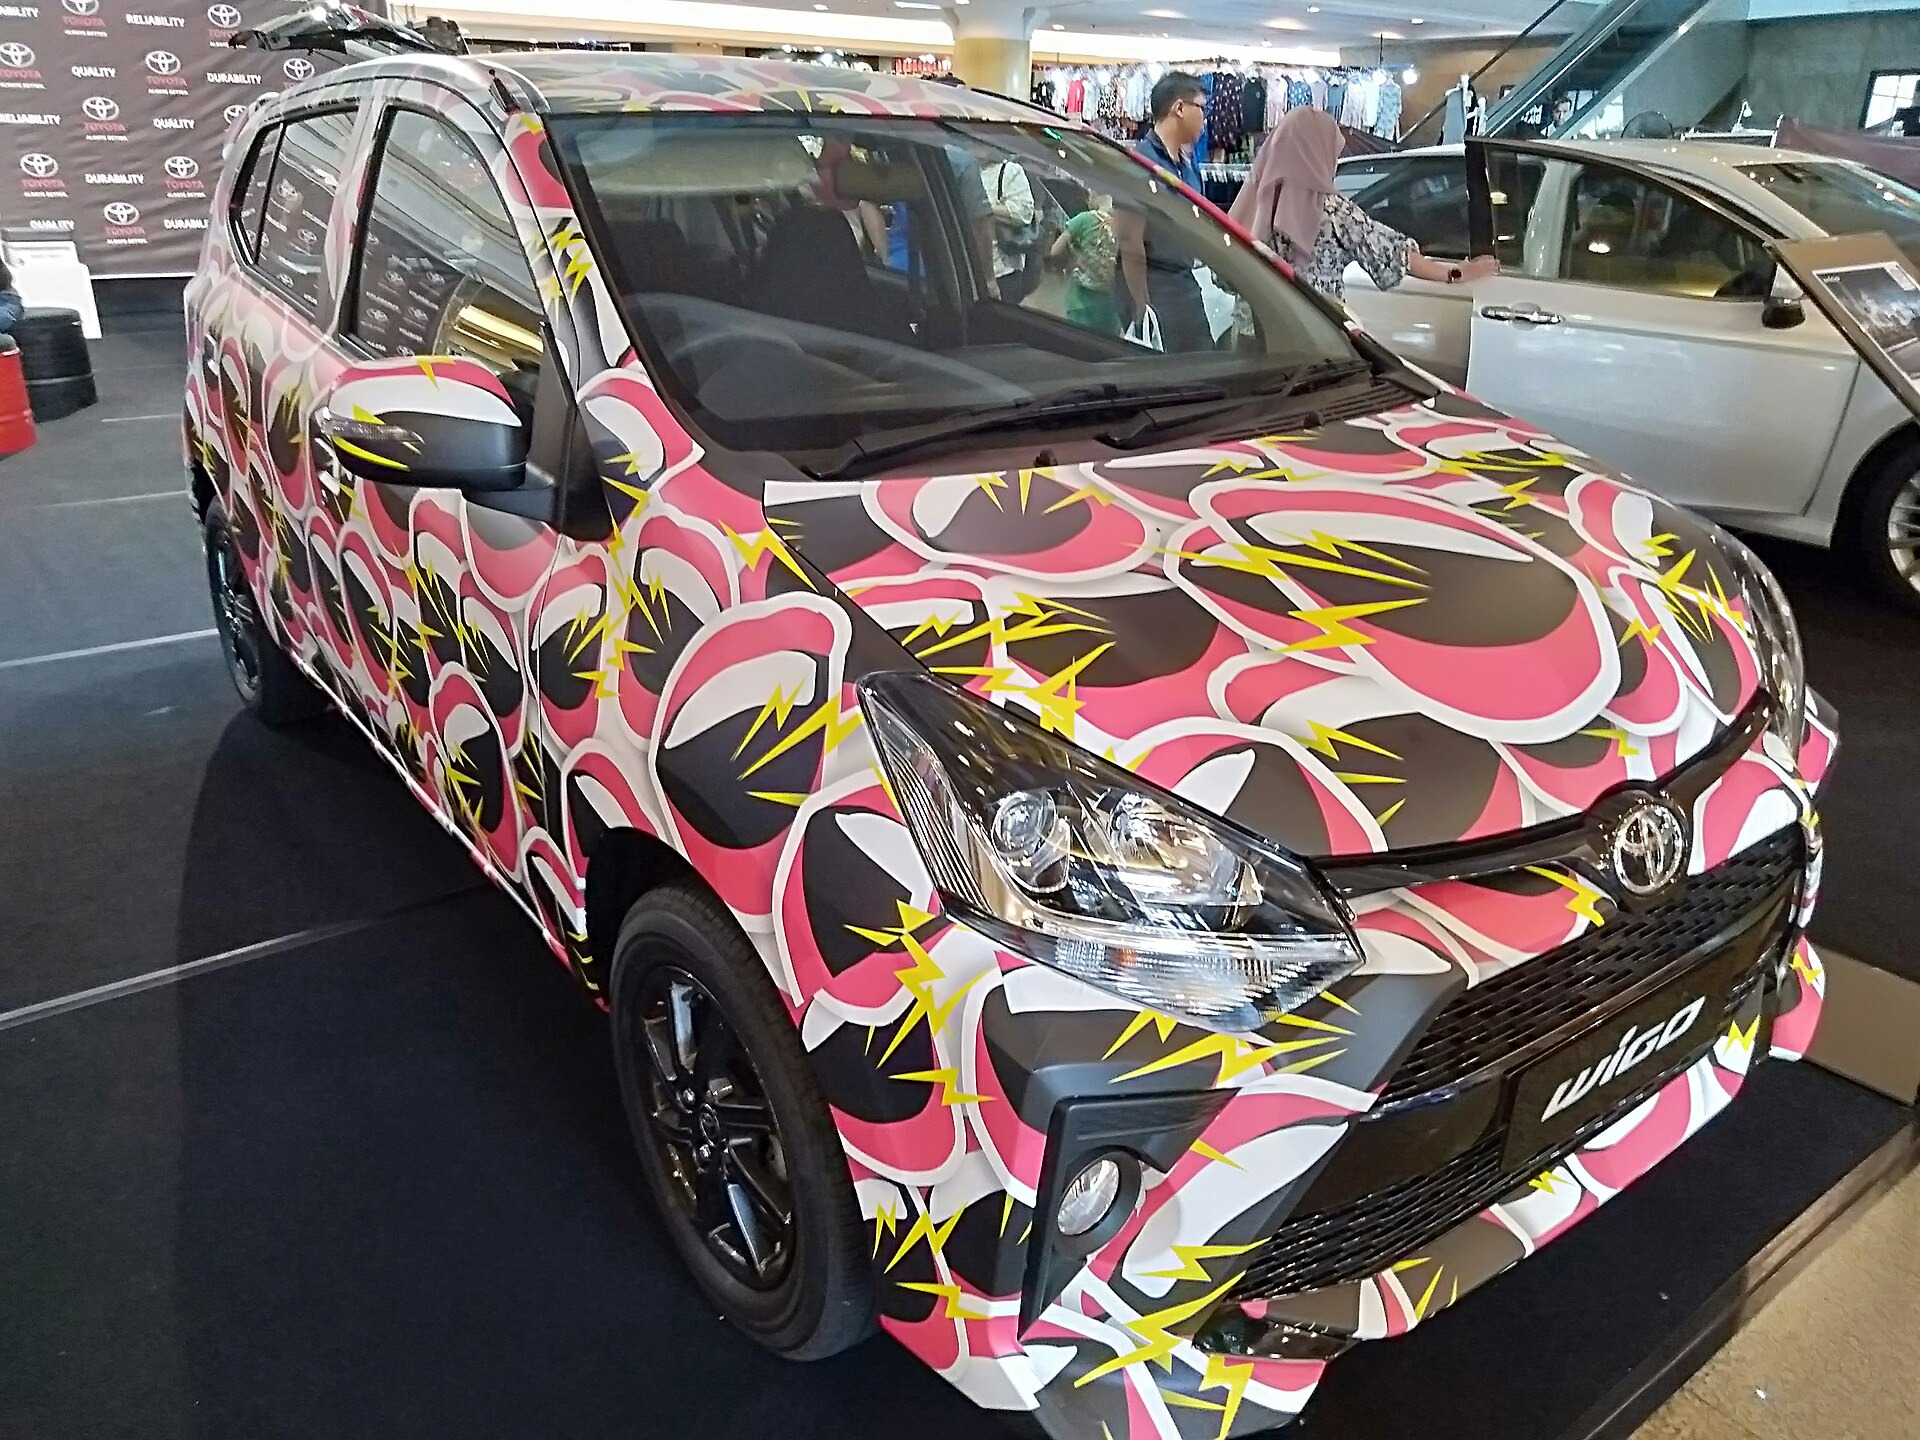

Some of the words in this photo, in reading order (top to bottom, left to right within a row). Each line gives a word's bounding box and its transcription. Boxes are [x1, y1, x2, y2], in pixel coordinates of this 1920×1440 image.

[126, 14, 186, 27] RELIABILITY
[71, 65, 116, 78] QUALITY
[146, 75, 187, 86] TOYOTA
[206, 72, 261, 85] DURABILITY
[84, 121, 126, 132] TOYOTA
[153, 118, 195, 129] QUALITY
[21, 179, 66, 189] TOYOTA
[85, 173, 144, 184] DURABILITY
[165, 180, 205, 189] TOYOTA
[29, 220, 75, 231] QUALITY
[104, 226, 146, 236] TOYOTA
